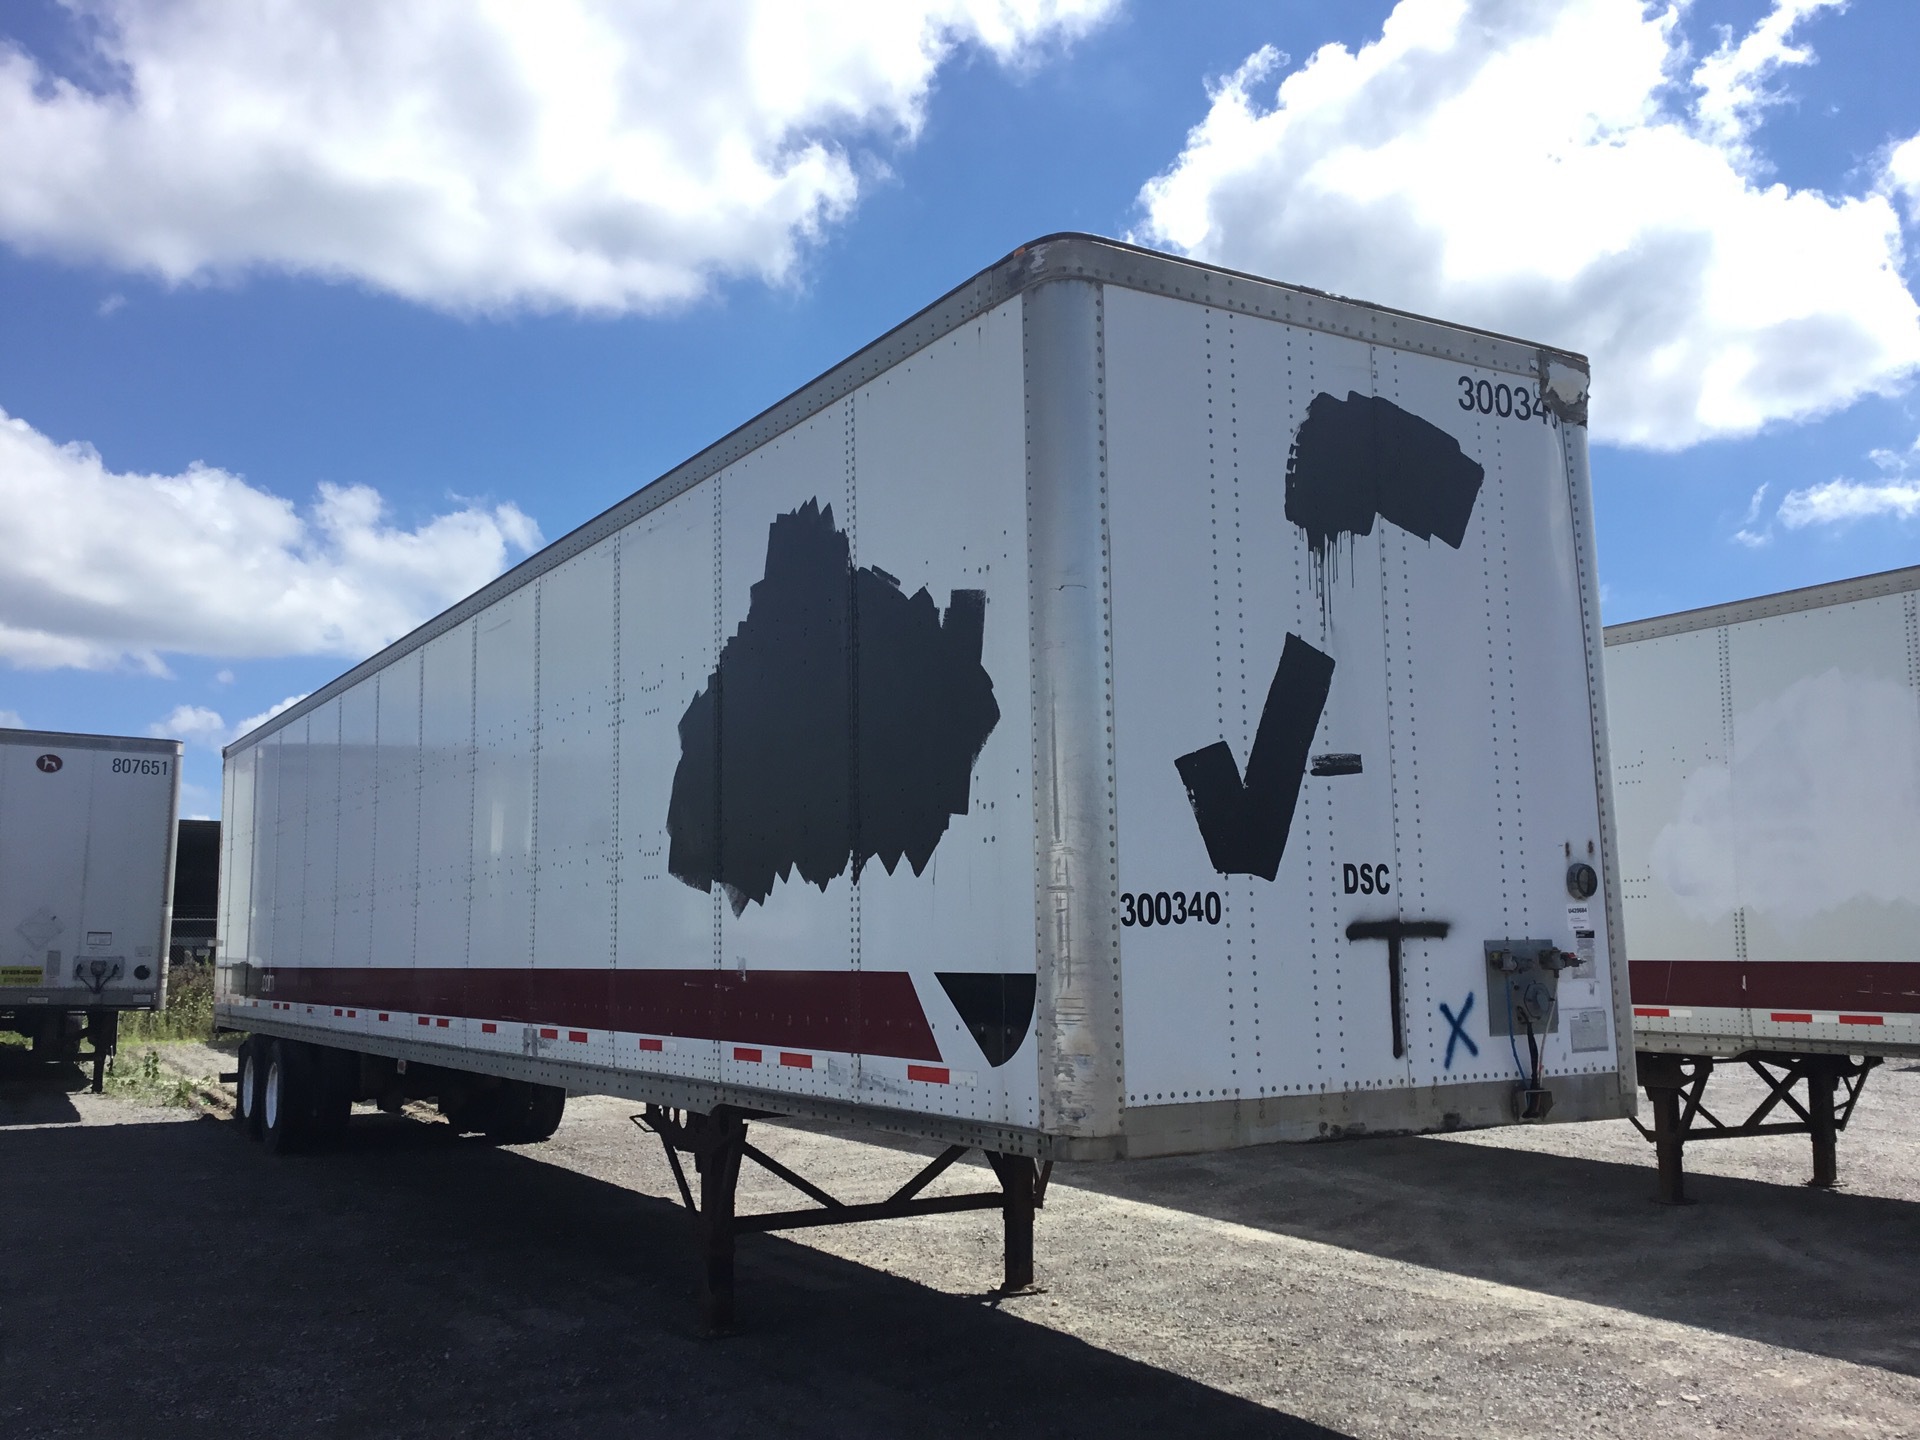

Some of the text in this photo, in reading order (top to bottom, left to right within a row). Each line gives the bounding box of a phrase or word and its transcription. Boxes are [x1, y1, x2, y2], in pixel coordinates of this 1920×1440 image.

[112, 758, 168, 776] 807651
[1343, 863, 1390, 895] DSC
[1120, 891, 1221, 927] 300340
[1345, 917, 1450, 1059] T
